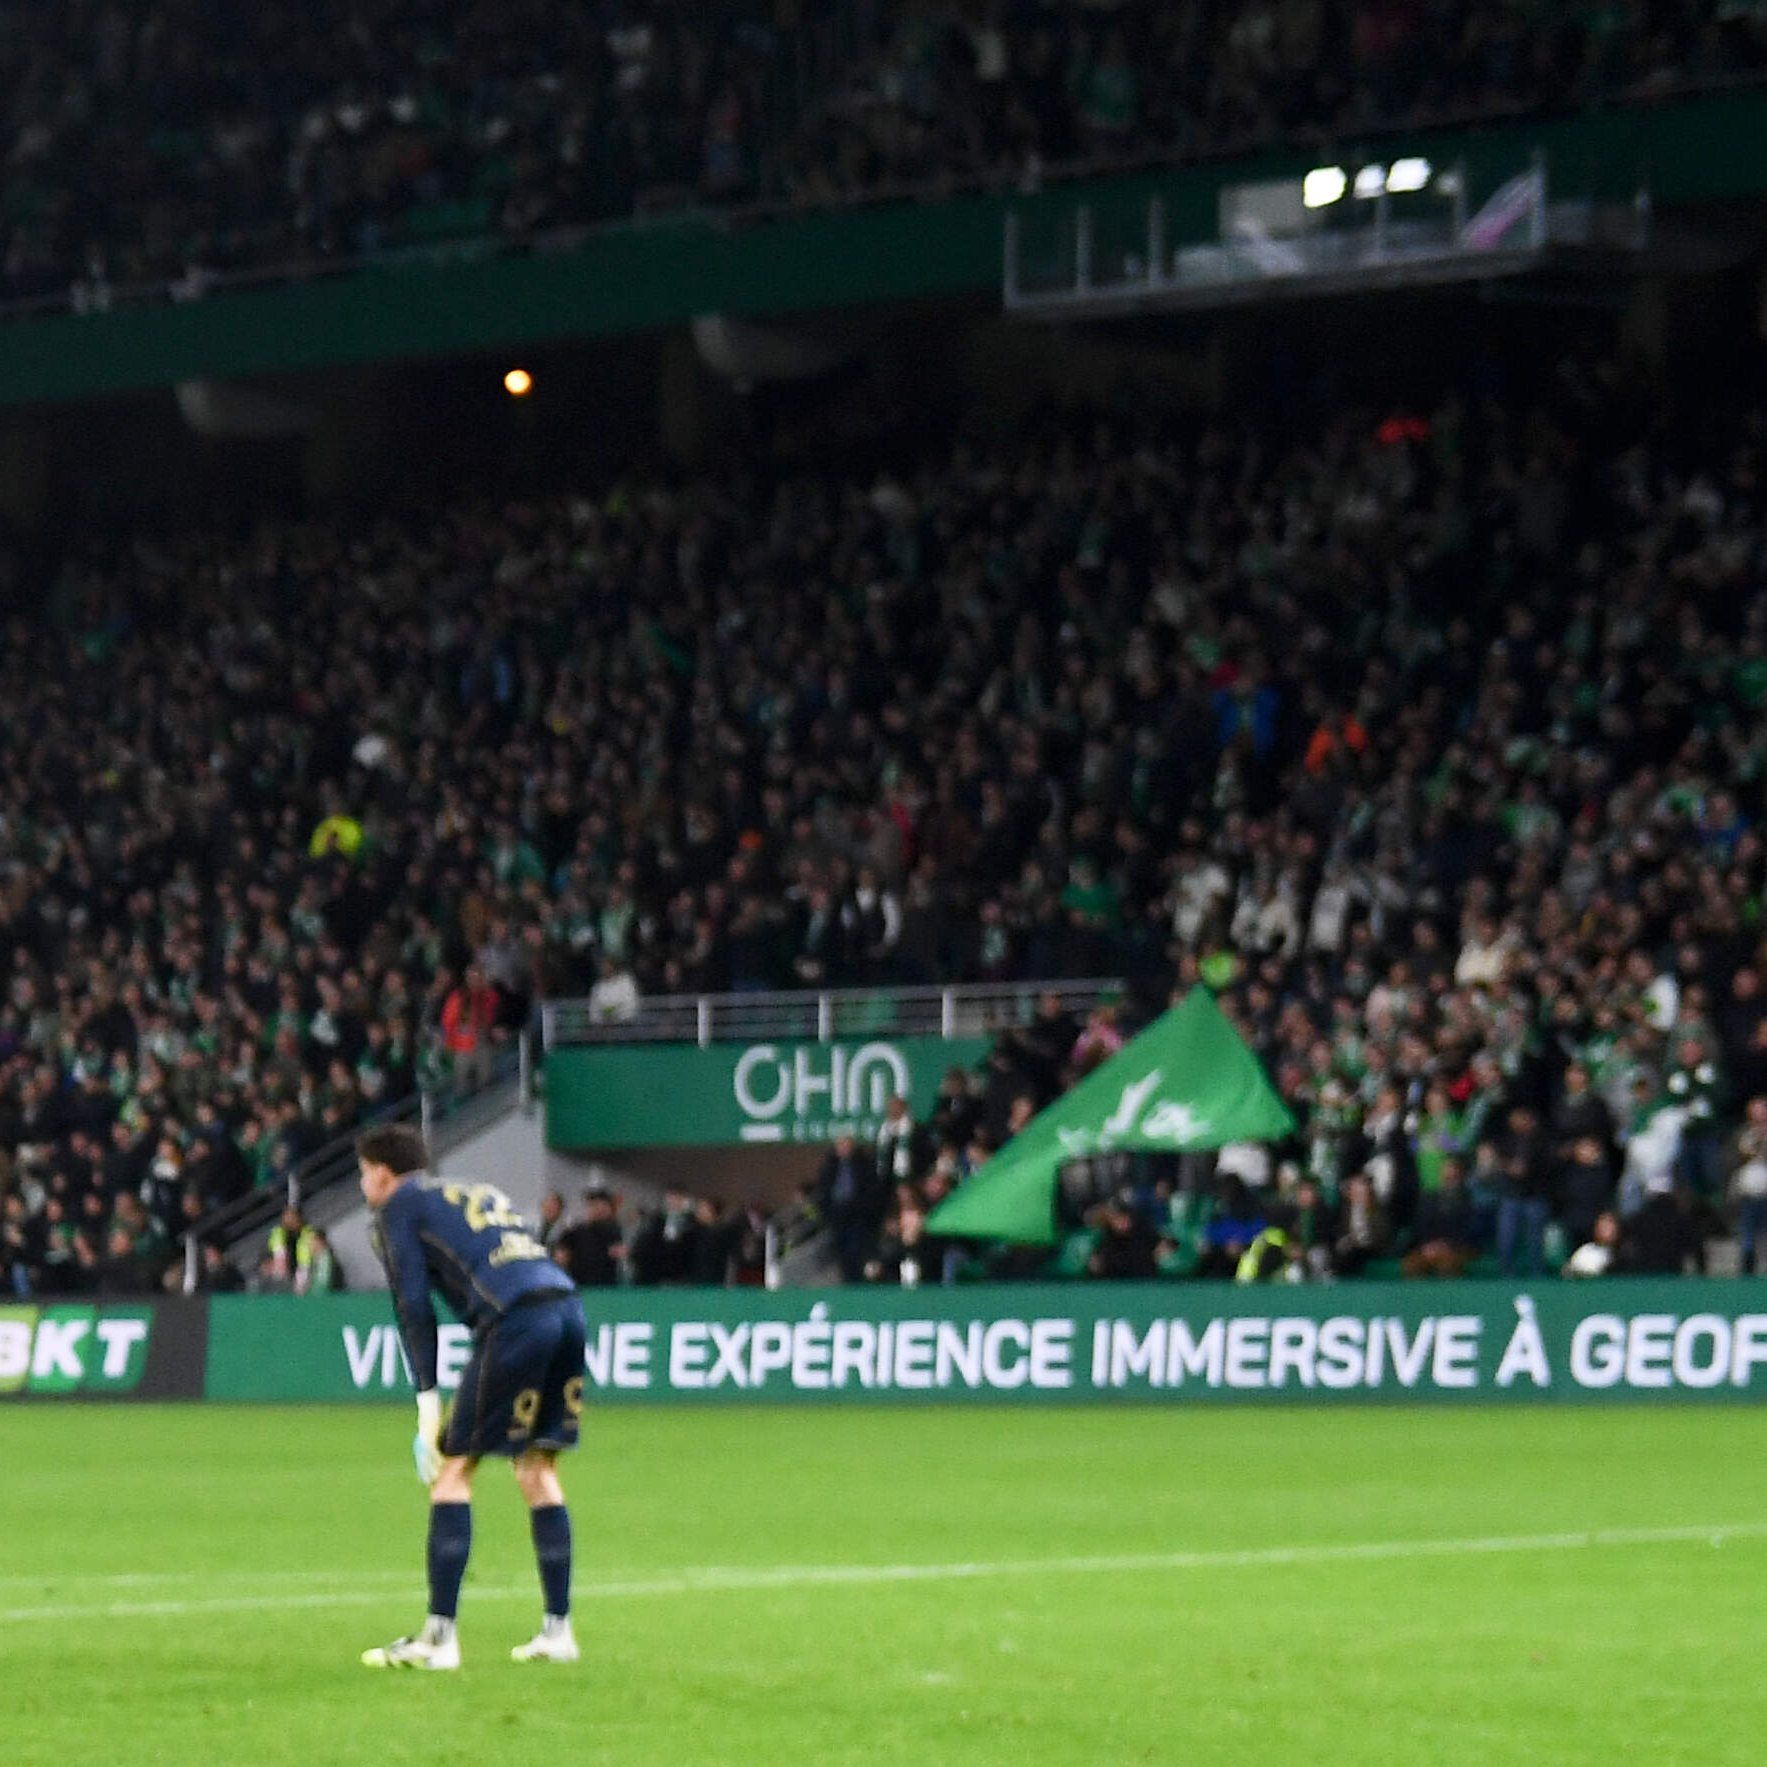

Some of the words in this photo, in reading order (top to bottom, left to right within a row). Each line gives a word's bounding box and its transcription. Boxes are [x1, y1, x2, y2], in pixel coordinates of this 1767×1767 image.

[669, 1301, 1075, 1389] EXPÉRIENCE
[1091, 1314, 1484, 1389] IMMERSIVE
[1494, 1295, 1552, 1389] À
[1569, 1312, 1767, 1390] GEOF
